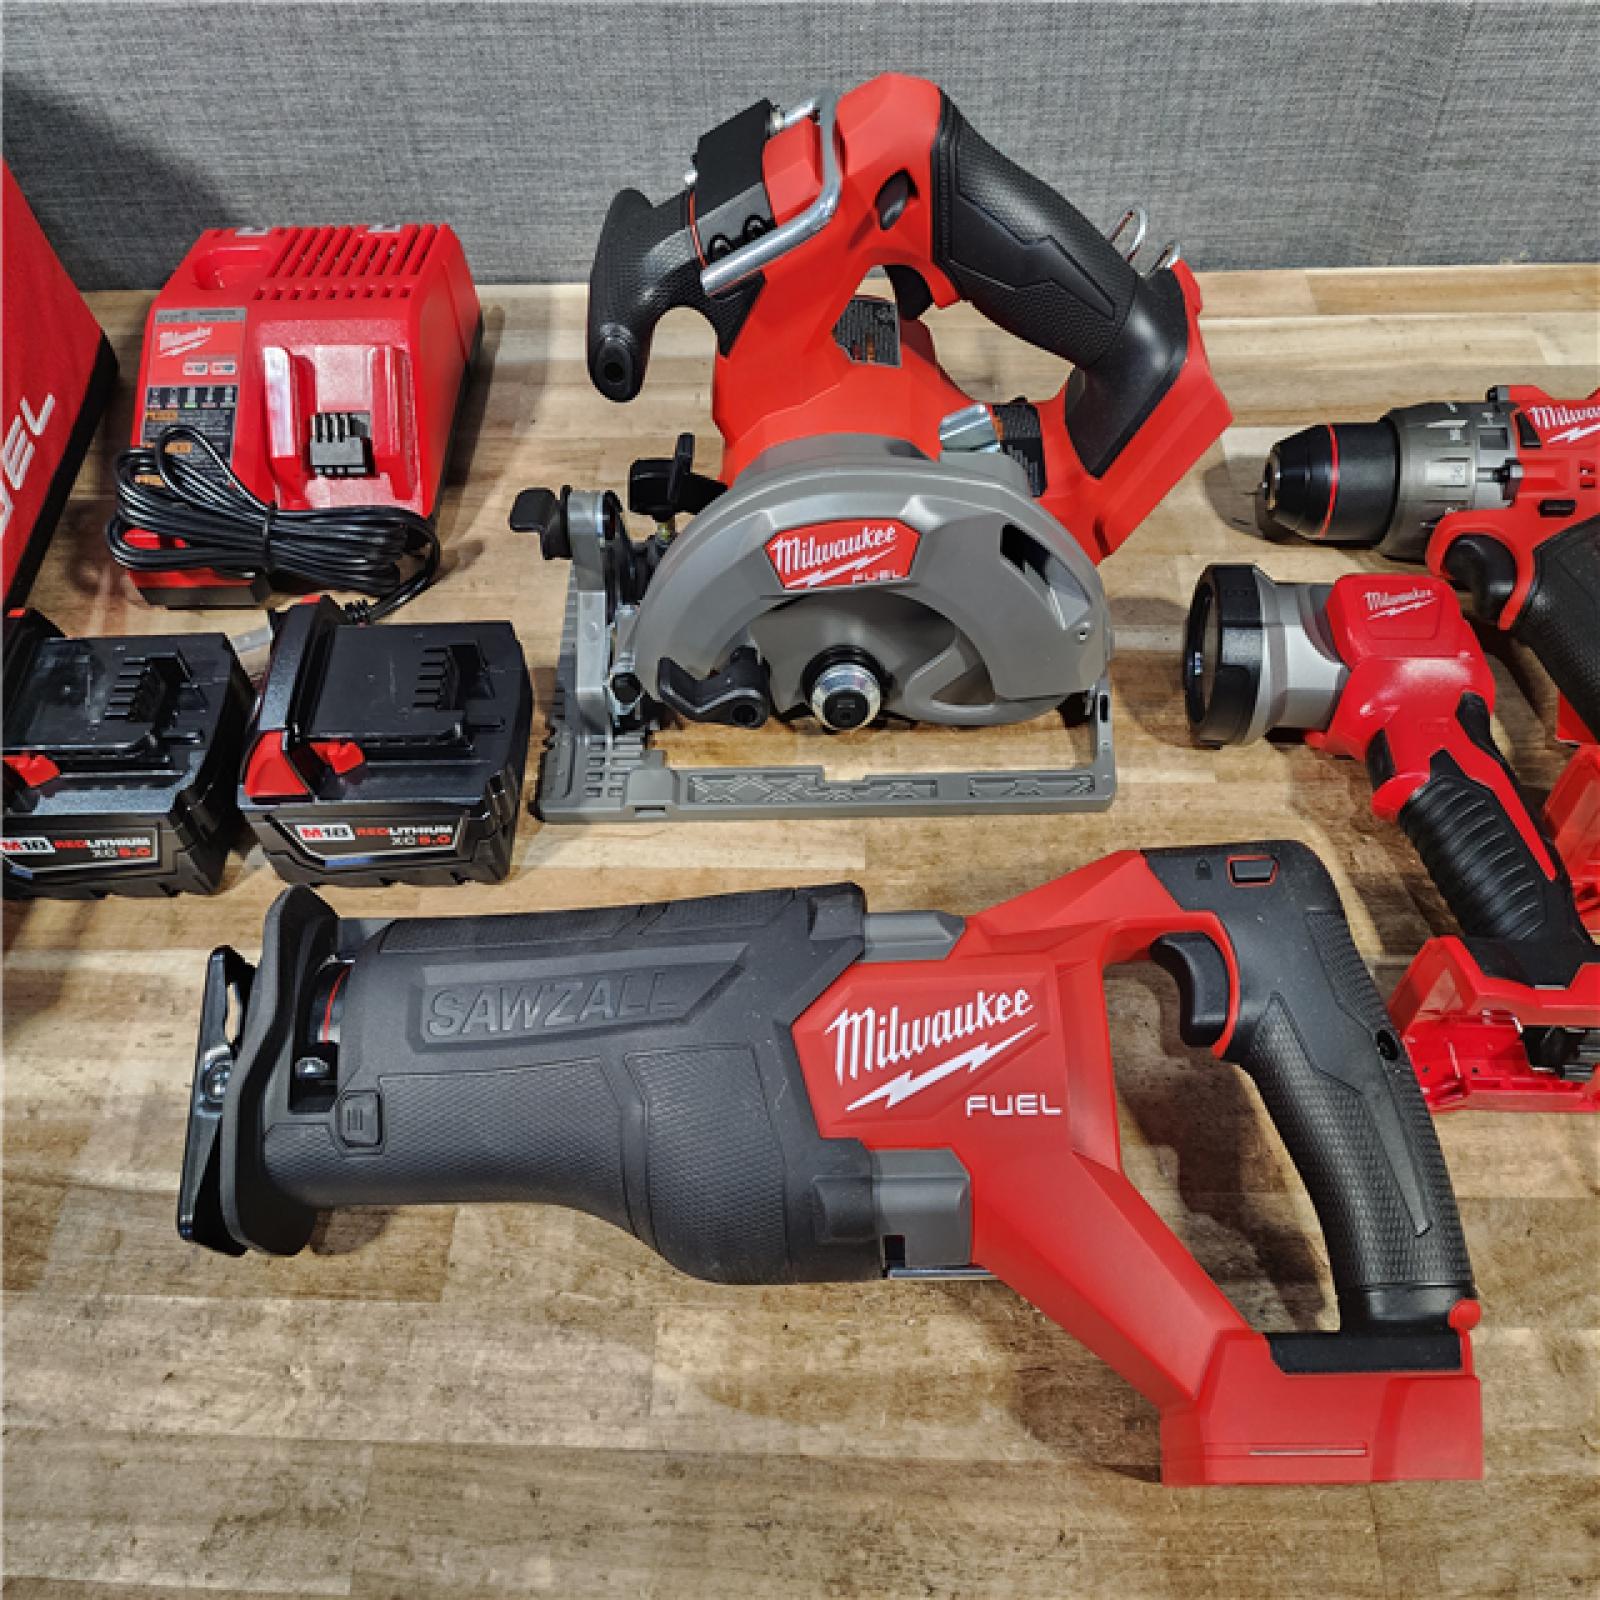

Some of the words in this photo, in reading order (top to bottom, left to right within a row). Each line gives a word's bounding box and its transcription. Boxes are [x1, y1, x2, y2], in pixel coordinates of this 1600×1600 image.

[770, 526, 897, 575] Milwaukee
[852, 569, 905, 583] FUEL
[1362, 587, 1433, 611] Milwaukee
[426, 970, 677, 1036] SAWZALL
[825, 988, 1035, 1086] Milwaukee
[965, 1094, 1062, 1118] FUEL
